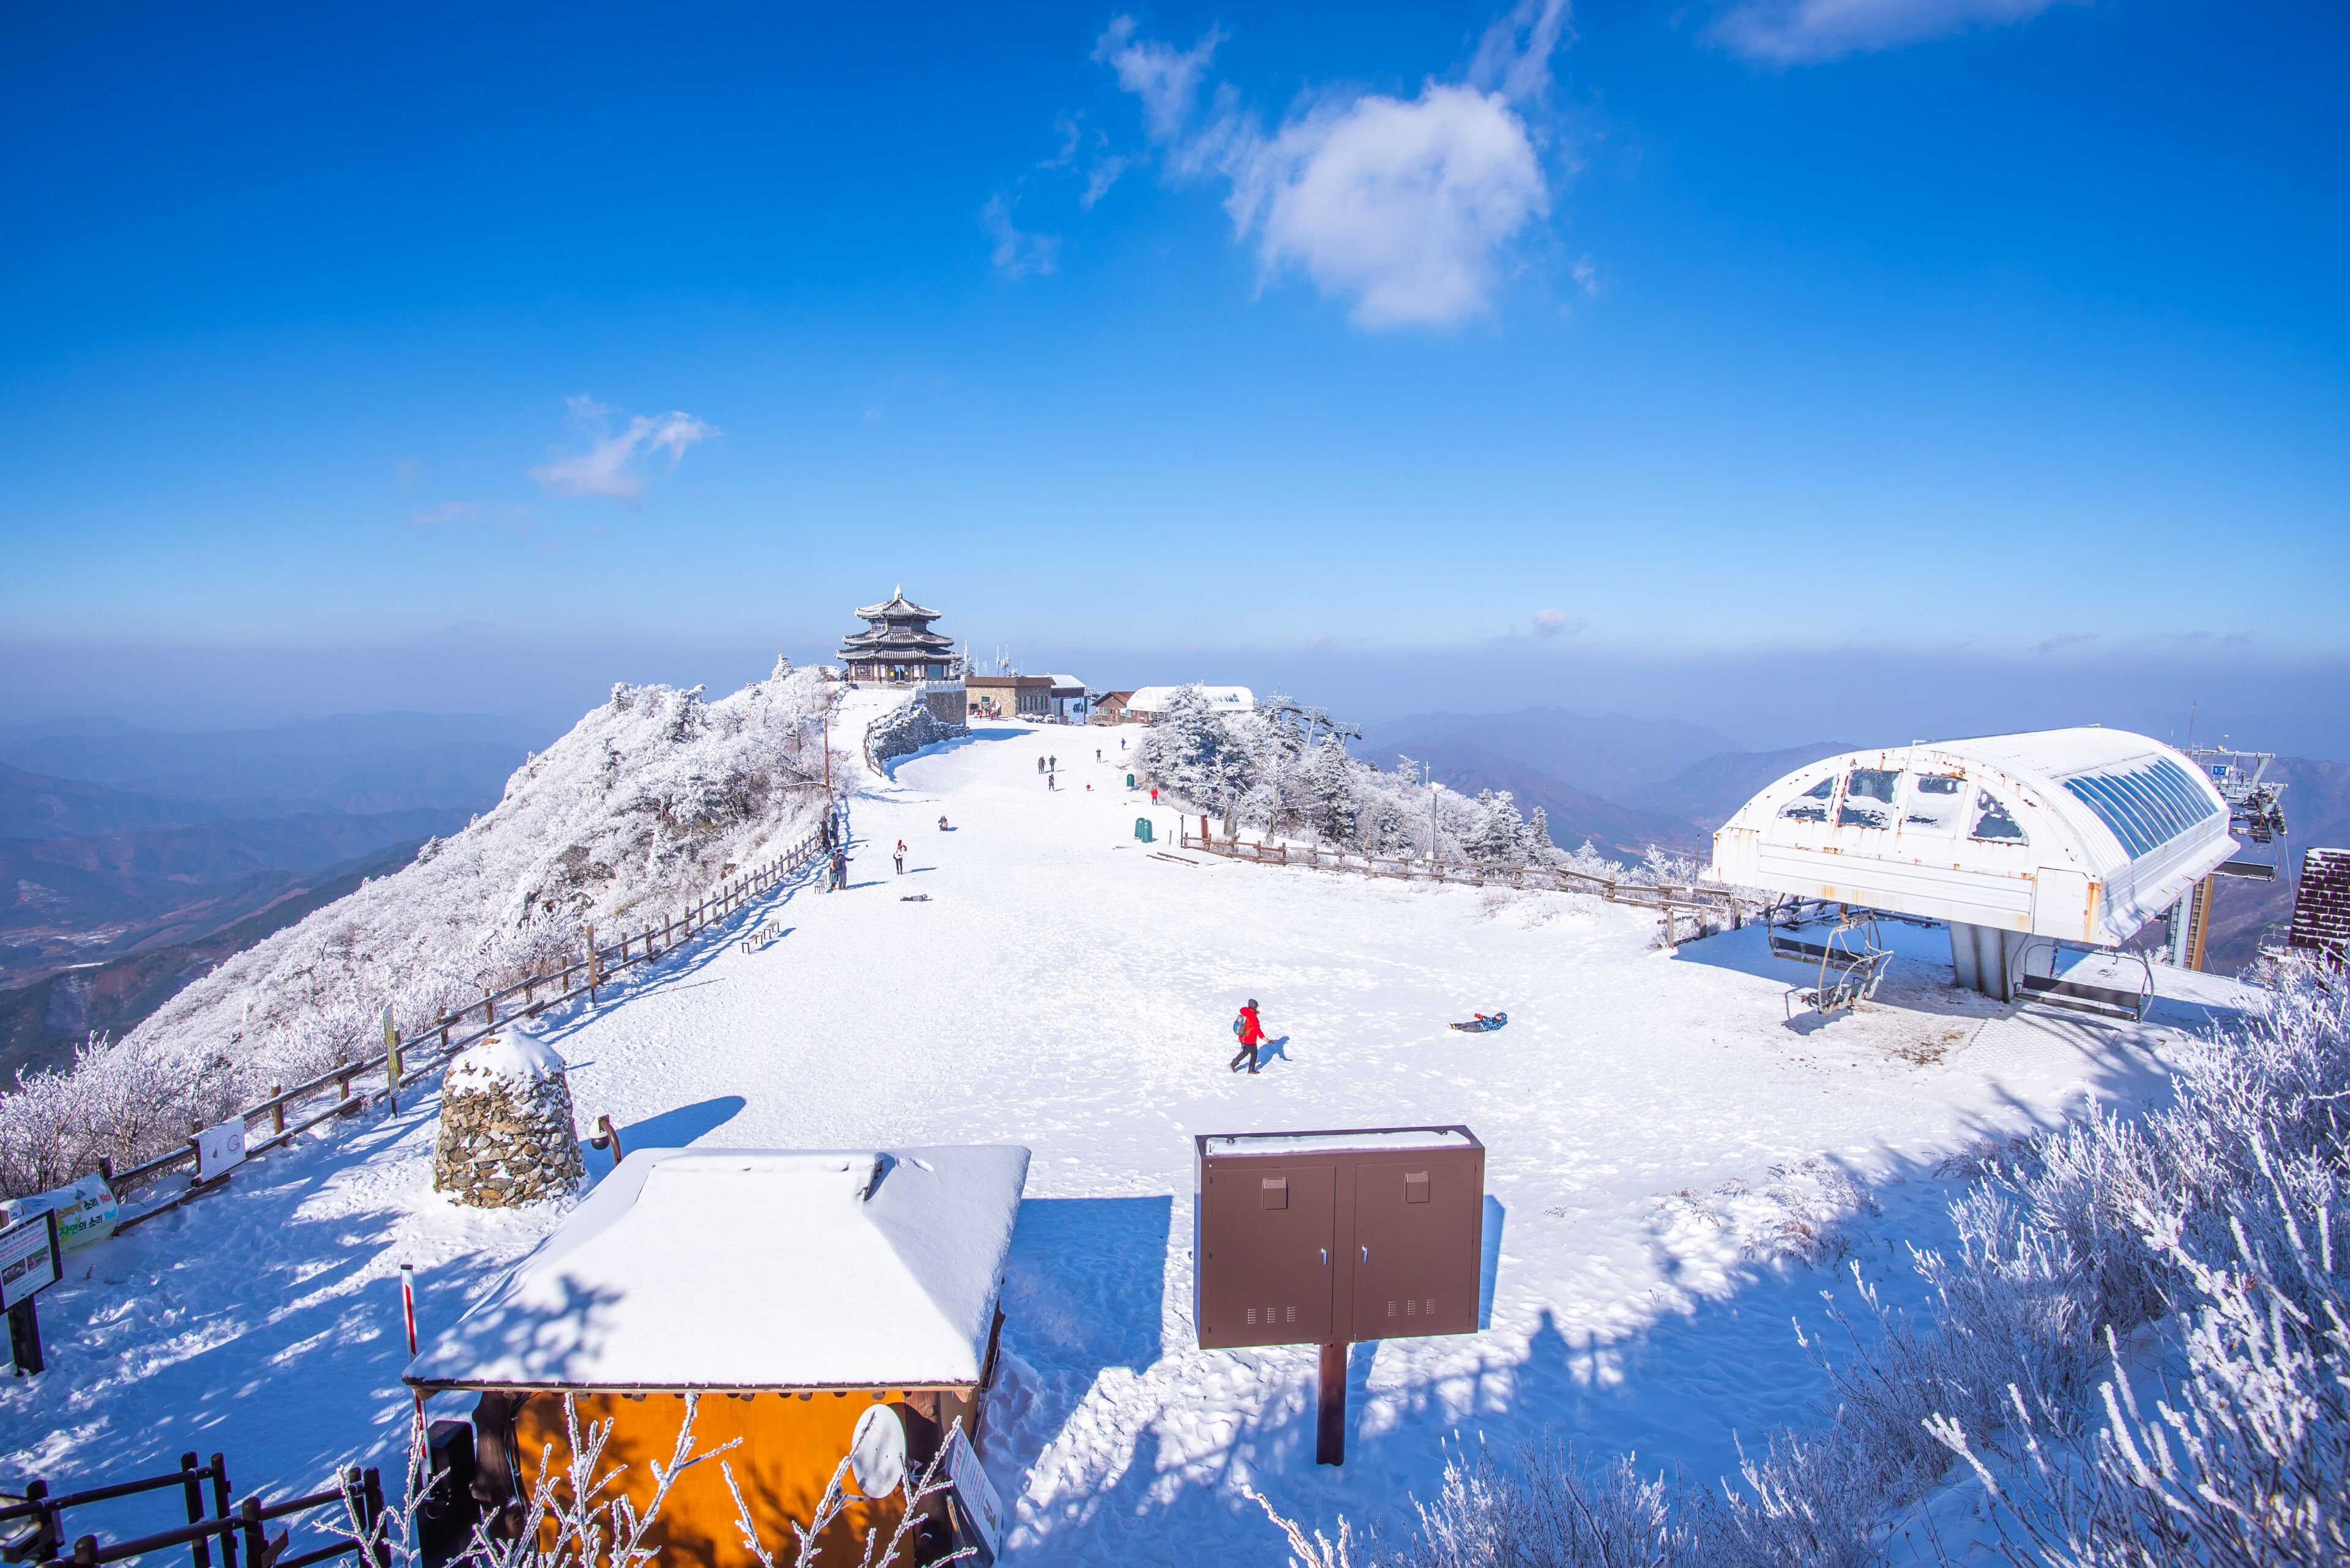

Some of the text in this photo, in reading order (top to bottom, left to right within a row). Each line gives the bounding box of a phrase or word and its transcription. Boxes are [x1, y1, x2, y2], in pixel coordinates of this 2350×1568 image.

[56, 1191, 112, 1219] 스피커 소리 No!
[59, 1221, 86, 1236] 자연의
[89, 1214, 102, 1228] 소리
[959, 1433, 965, 1450] 안내
